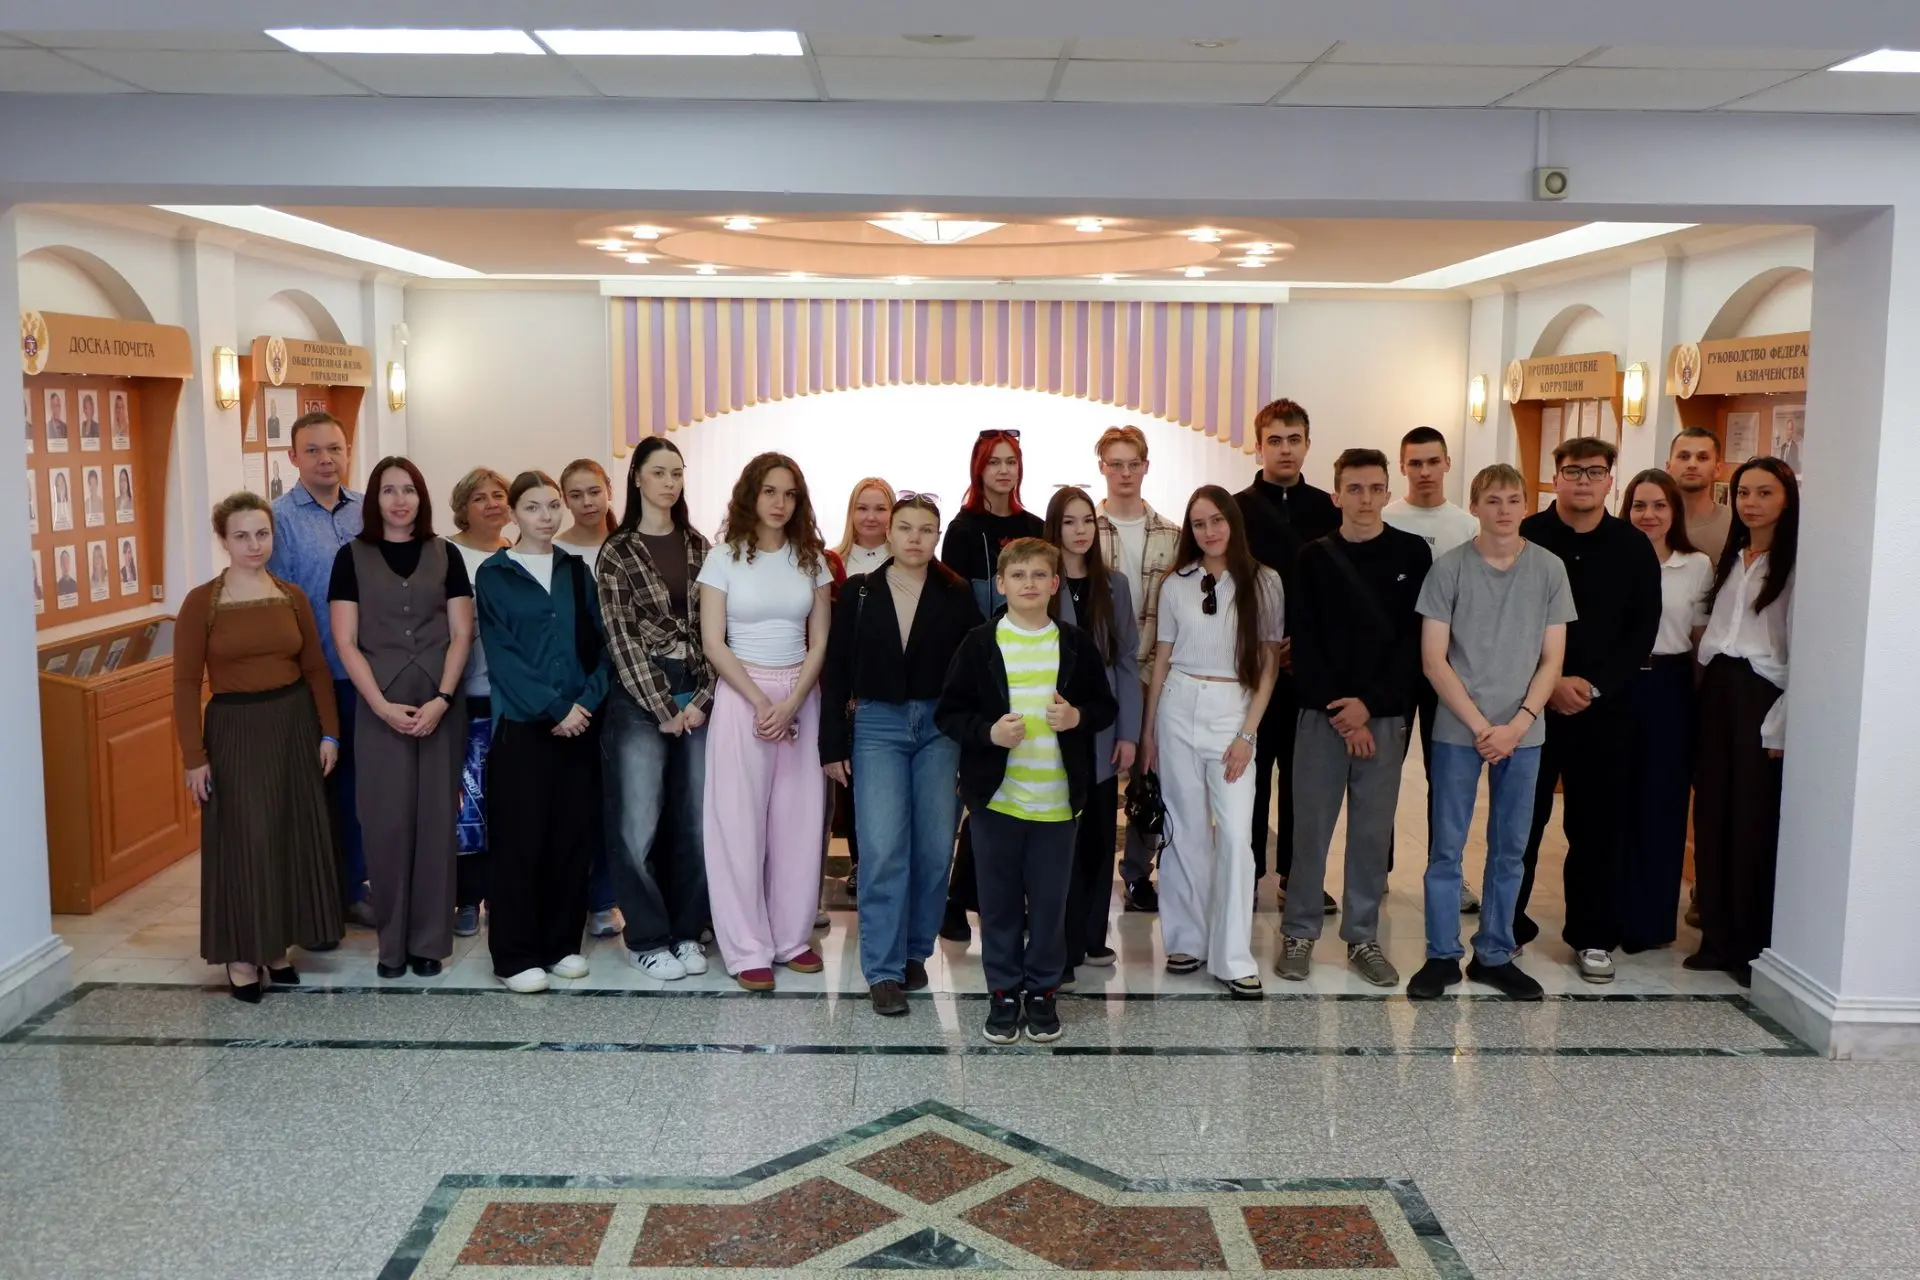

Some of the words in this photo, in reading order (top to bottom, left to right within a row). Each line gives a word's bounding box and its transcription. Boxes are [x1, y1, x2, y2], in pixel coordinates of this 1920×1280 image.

[69, 335, 111, 355] ДОСКА
[114, 340, 155, 358] ПОЧЕТА
[1707, 348, 1766, 364] РУКОВОДСТВО
[1540, 380, 1584, 393] КОРРУПЦИИ
